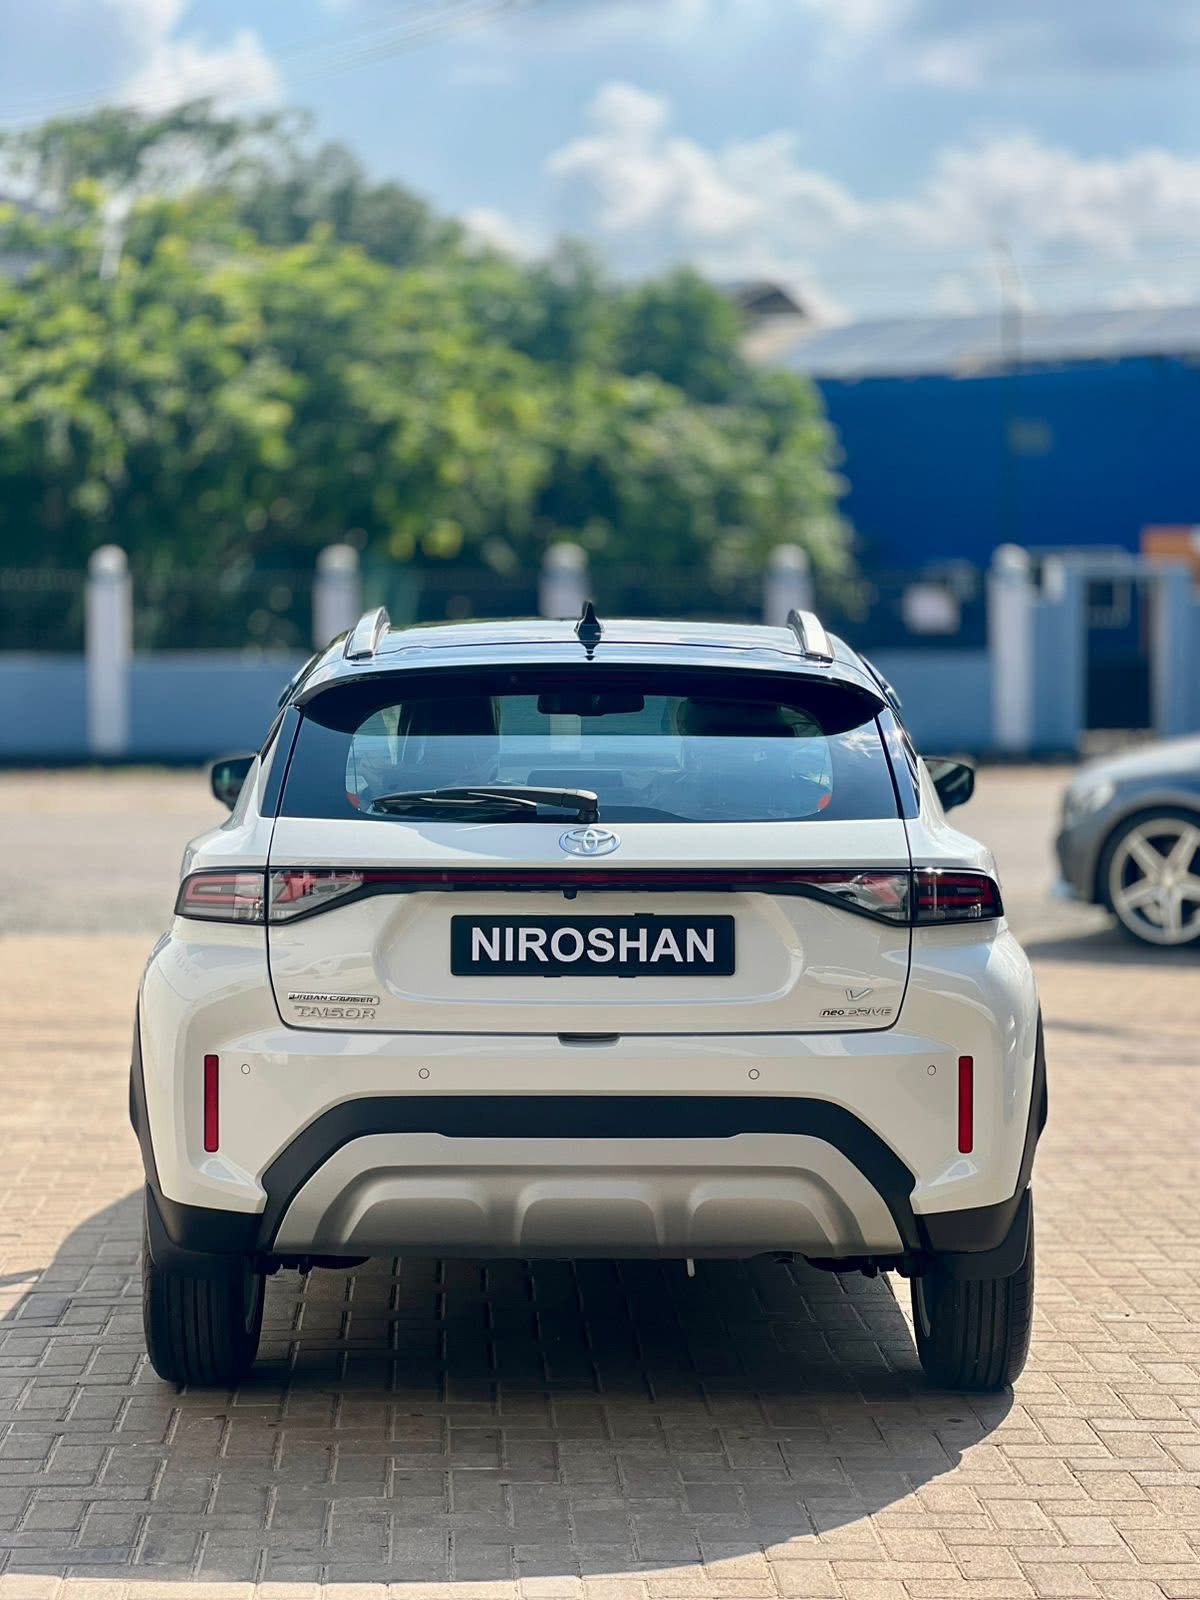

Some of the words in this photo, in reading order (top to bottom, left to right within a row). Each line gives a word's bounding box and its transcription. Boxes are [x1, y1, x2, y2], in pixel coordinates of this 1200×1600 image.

[471, 927, 715, 963] NIROSHAN
[289, 992, 328, 1002] URBAN
[329, 994, 374, 1003] CRUISER
[294, 1005, 376, 1019] TAISOR
[822, 1008, 845, 1017] neo
[847, 1007, 892, 1017] DRIVE
